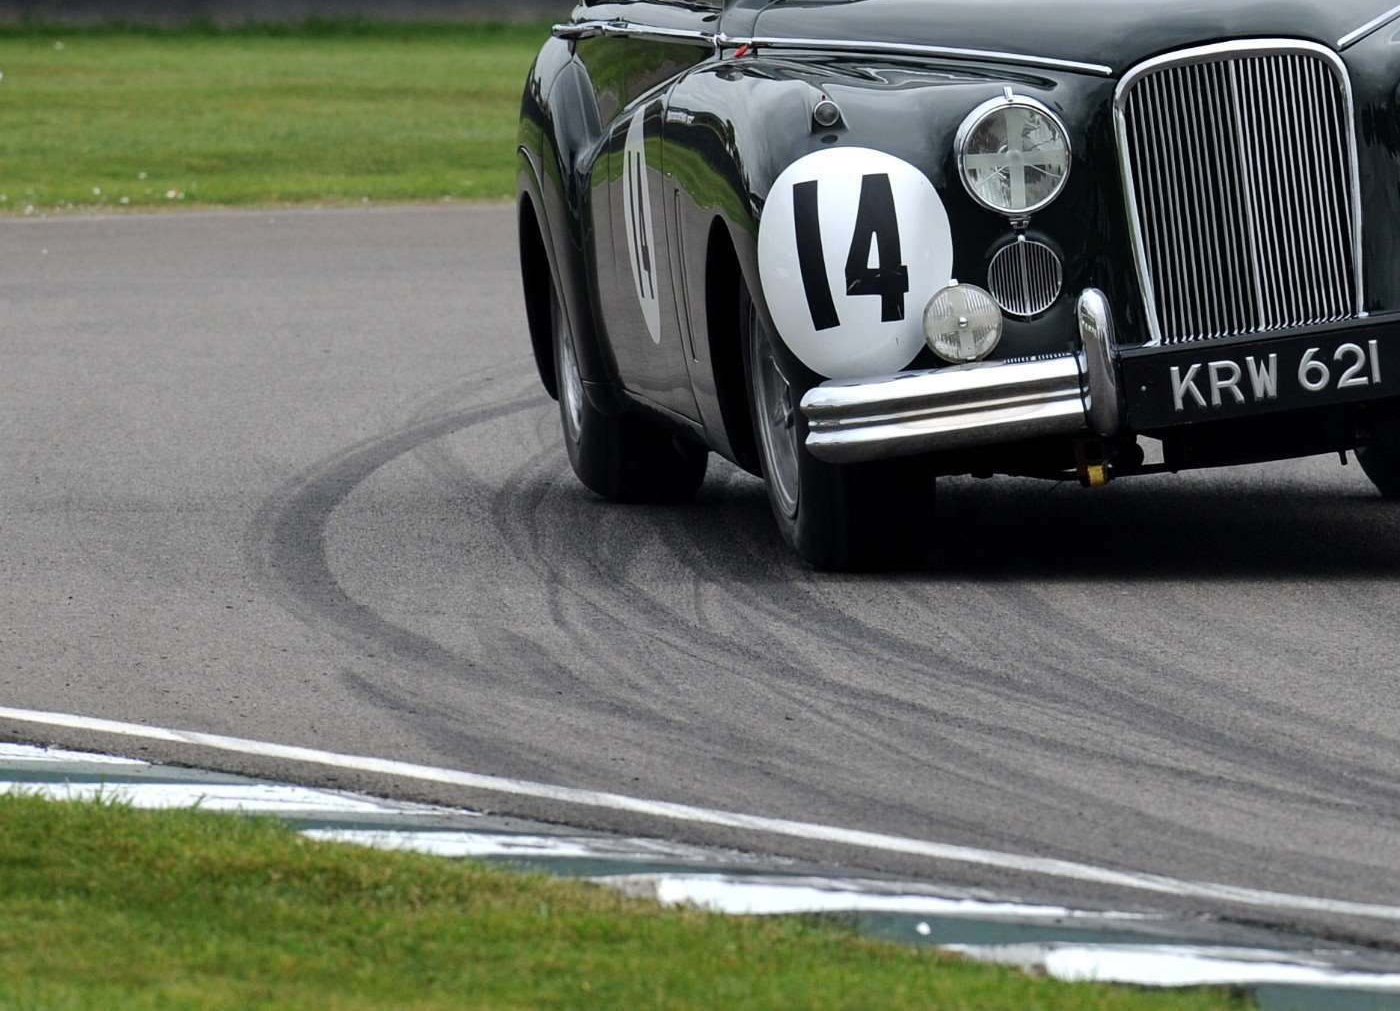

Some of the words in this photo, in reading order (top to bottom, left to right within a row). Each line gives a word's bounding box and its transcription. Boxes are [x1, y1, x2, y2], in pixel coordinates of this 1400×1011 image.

[793, 173, 909, 331] 14
[1169, 353, 1278, 412] KRW
[1297, 339, 1382, 391] 621
